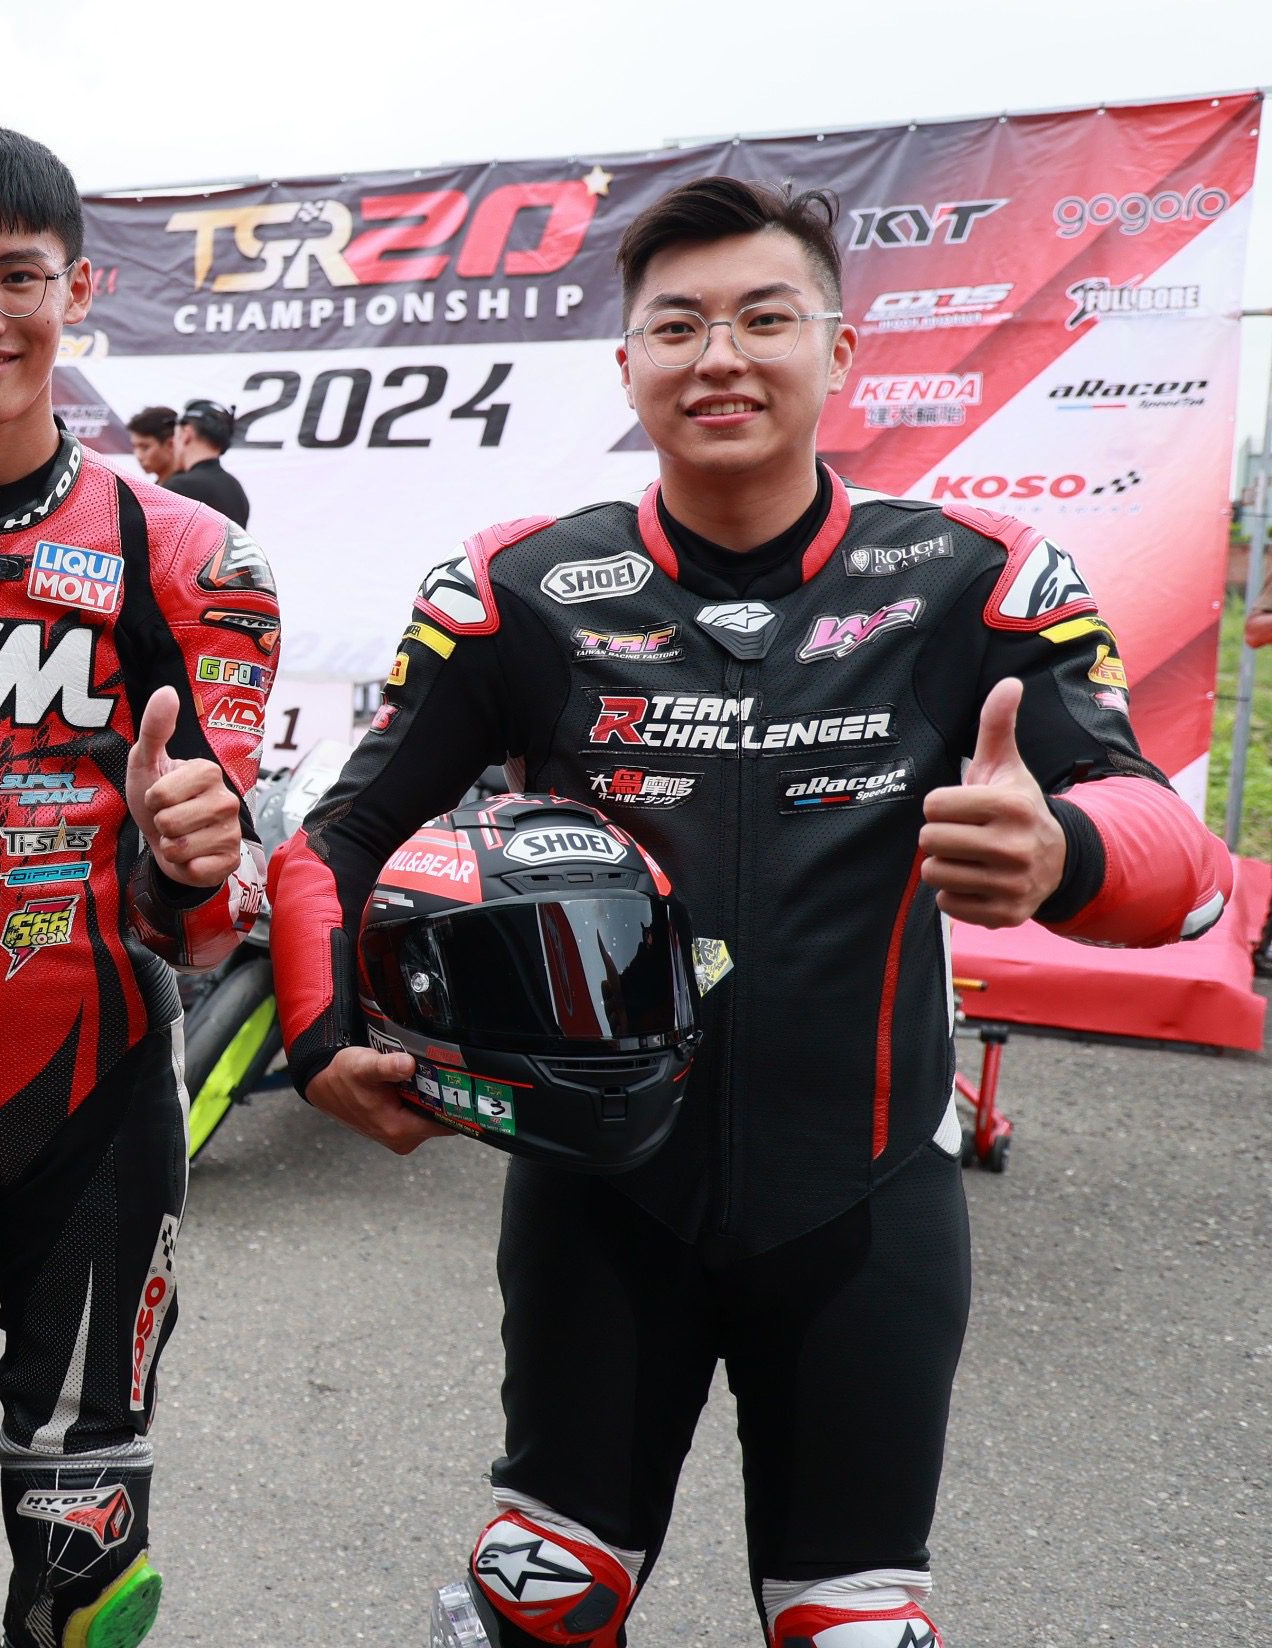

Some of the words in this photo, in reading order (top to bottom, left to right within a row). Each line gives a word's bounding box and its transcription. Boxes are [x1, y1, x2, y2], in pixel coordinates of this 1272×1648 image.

[851, 199, 1010, 249] KYT
[1054, 185, 1229, 238] gogoro
[174, 286, 583, 334] CHAMPIONSHIP
[856, 376, 980, 403] KENDA
[1048, 380, 1208, 398] aRacer
[228, 363, 513, 449] 2024
[4, 446, 80, 528] HYOD
[931, 475, 1086, 499] KOSO
[39, 543, 117, 582] LIQUI
[875, 537, 943, 563] ROUGH
[875, 548, 944, 572] CRAFTS
[35, 575, 115, 607] MOLY
[559, 562, 636, 595] SHOEI
[577, 626, 677, 653] TRF
[576, 649, 607, 657] TAIWAN
[608, 651, 640, 659] RACING
[642, 650, 681, 660] FACTORY
[651, 696, 754, 721] TEAM
[274, 707, 300, 750] 1
[642, 713, 891, 750] CHALLENGER
[0, 773, 76, 790] SUPER
[785, 768, 907, 796] aRacer
[18, 787, 99, 805] BRAKE
[523, 832, 614, 857] SHOEI
[490, 1097, 506, 1116] 3
[26, 1494, 99, 1506] HYOD
